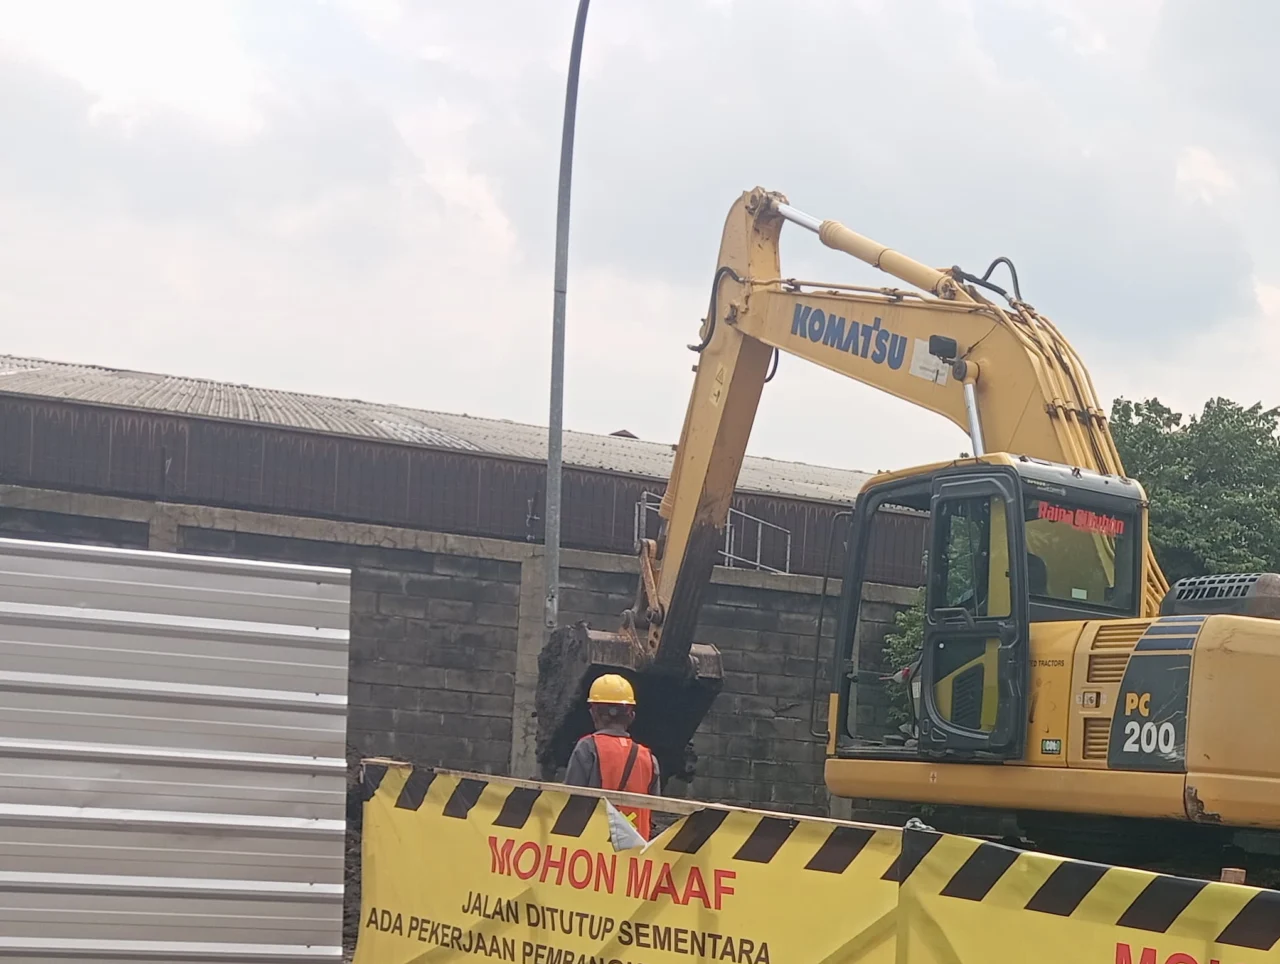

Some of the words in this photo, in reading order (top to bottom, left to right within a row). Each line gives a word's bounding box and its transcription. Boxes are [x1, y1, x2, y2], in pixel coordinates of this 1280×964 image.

[791, 303, 907, 370] KOMATSU
[1125, 693, 1150, 717] PC
[1123, 721, 1176, 753] 200
[488, 836, 617, 895] MOHON
[626, 857, 737, 911] MAAF
[366, 907, 404, 937] ADA
[407, 917, 516, 963] PEKERJAAN
[462, 890, 520, 925] JALAN
[526, 905, 615, 941] DITUTUP
